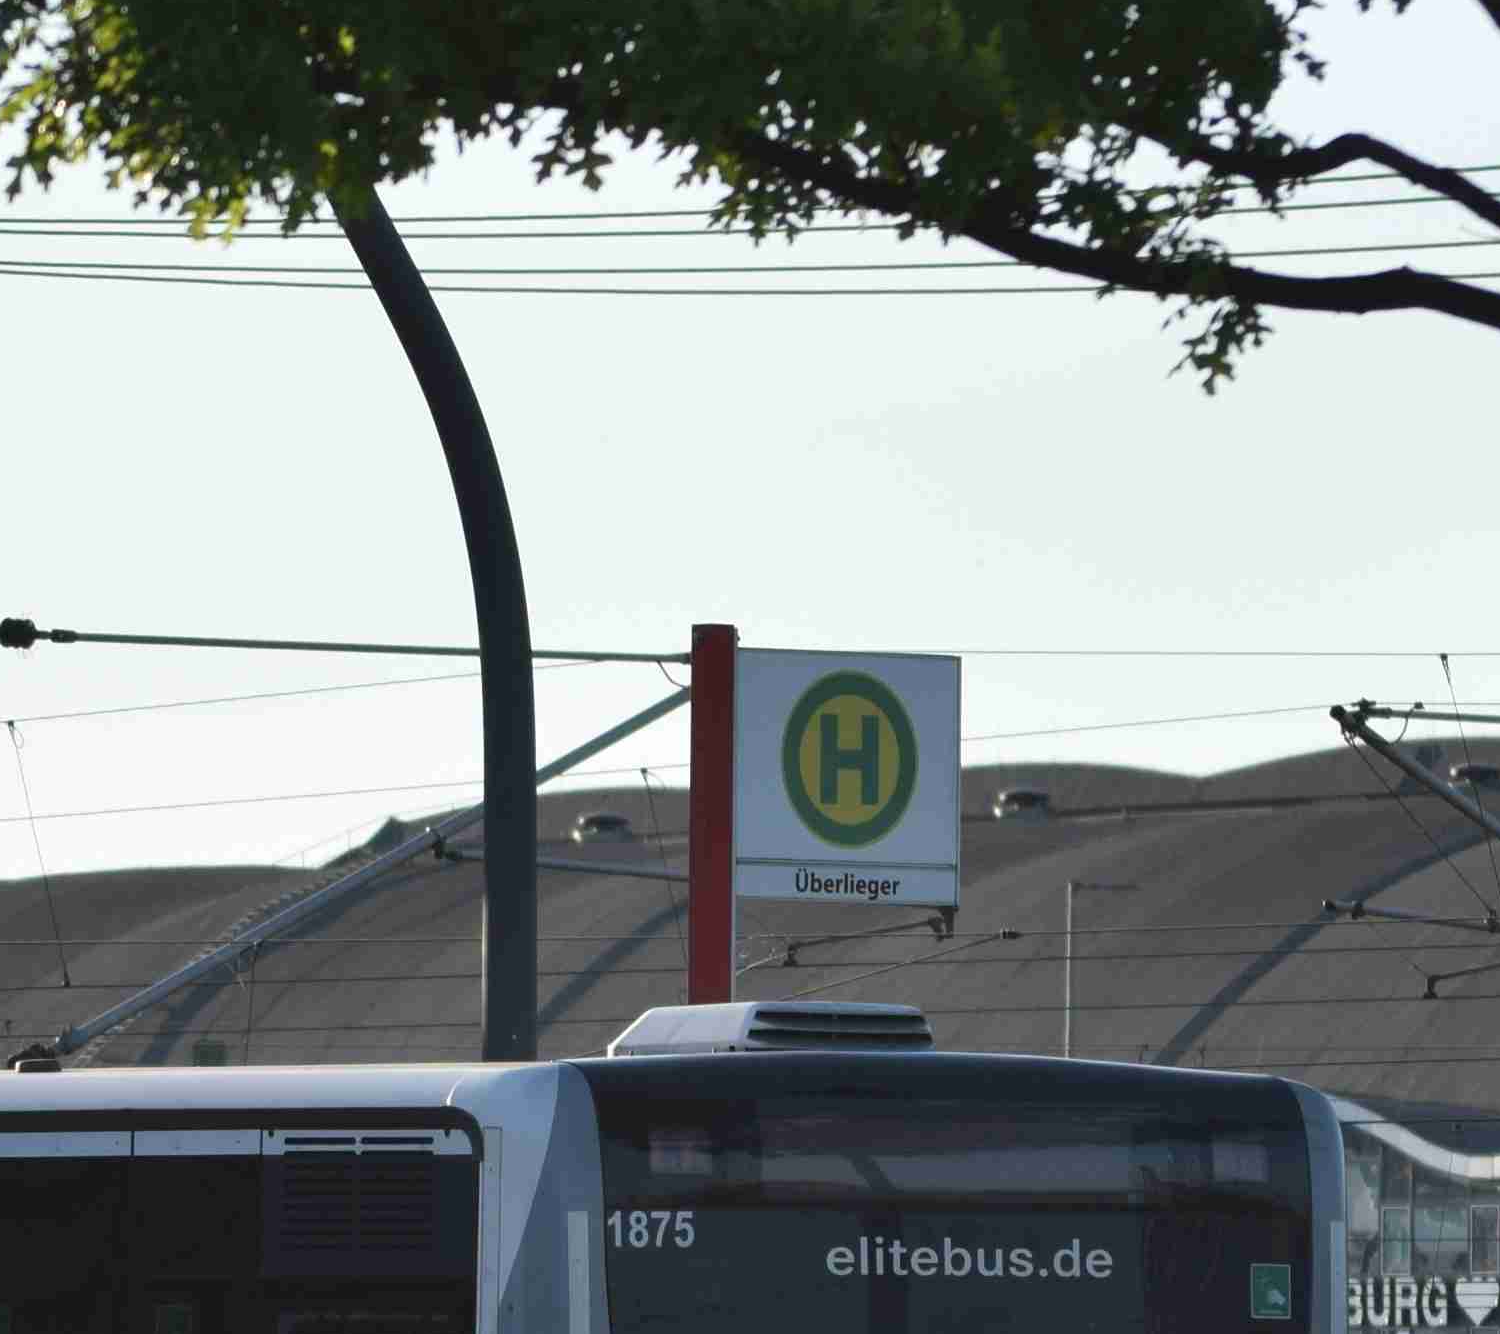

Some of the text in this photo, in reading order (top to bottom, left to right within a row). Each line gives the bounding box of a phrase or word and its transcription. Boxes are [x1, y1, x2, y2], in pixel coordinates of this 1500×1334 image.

[819, 712, 881, 806] H
[795, 868, 901, 900] Überlieger
[606, 1209, 696, 1251] 1875
[825, 1235, 1114, 1279] elitebus.de
